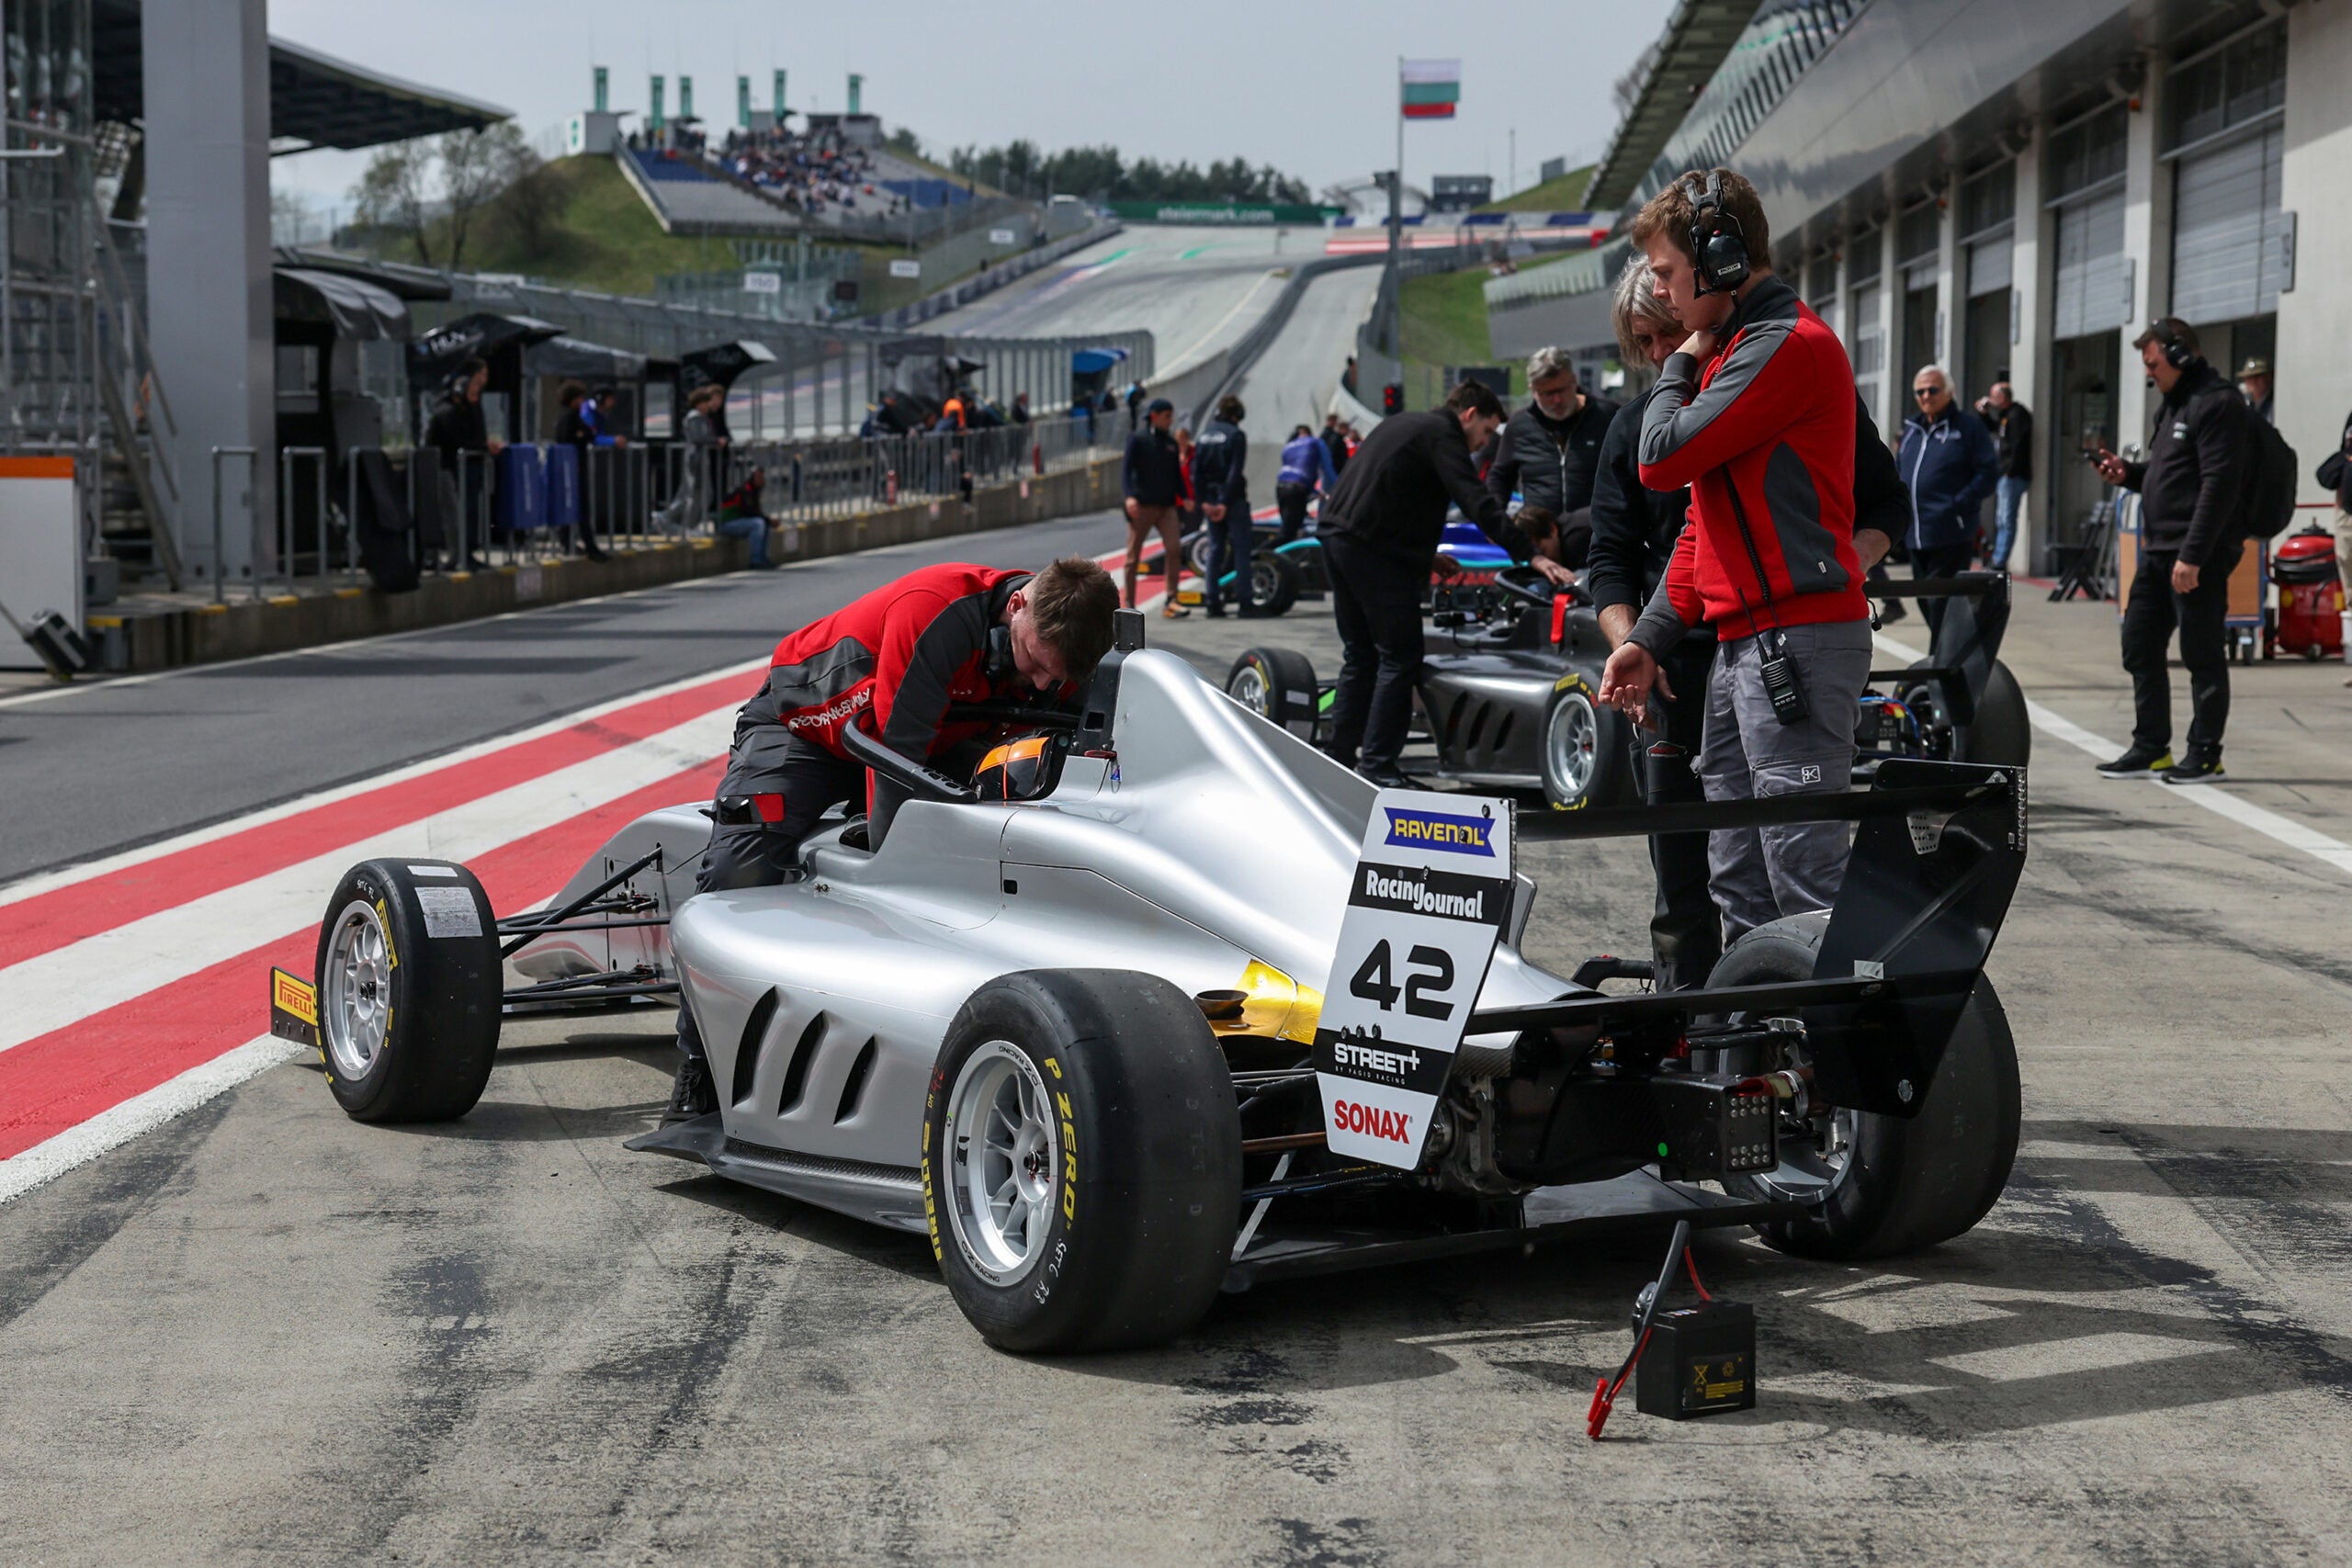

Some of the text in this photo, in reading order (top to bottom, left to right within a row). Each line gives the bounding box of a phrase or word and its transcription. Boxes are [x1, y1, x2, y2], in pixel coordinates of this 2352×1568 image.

[1156, 206, 1274, 223] steiermark.com
[278, 979, 311, 1017] PIRELLI
[1350, 938, 1455, 1022] 42
[999, 1045, 1025, 1065] RACING
[1044, 1057, 1077, 1221] P ZERO
[1334, 1100, 1410, 1145] SONAX
[974, 1263, 1001, 1283] RACING
